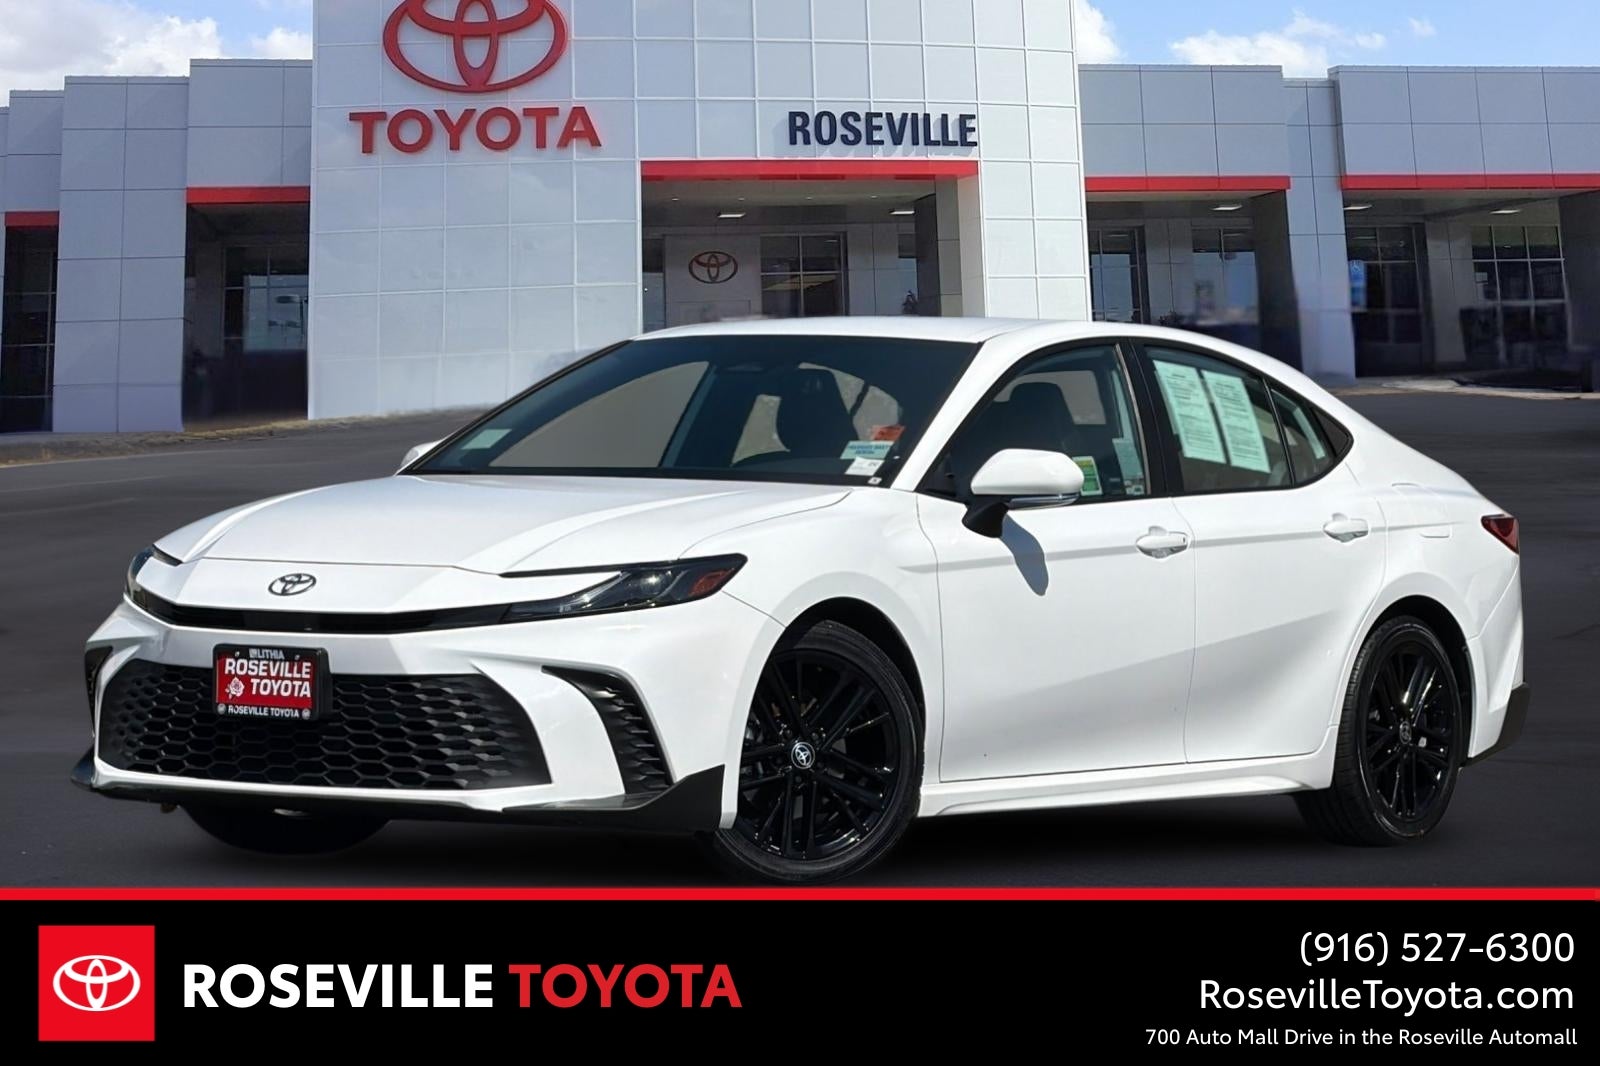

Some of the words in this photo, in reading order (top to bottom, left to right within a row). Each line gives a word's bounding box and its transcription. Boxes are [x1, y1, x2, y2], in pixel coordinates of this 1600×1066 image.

[350, 106, 601, 154] TOYOTA
[788, 110, 978, 148] ROSEVILLE
[257, 648, 285, 659] LITHIA
[224, 657, 312, 678] ROSEVILLE
[250, 678, 311, 697] TOYOTA
[228, 705, 268, 716] ROSEVILLE
[270, 708, 300, 718] TOYOTA
